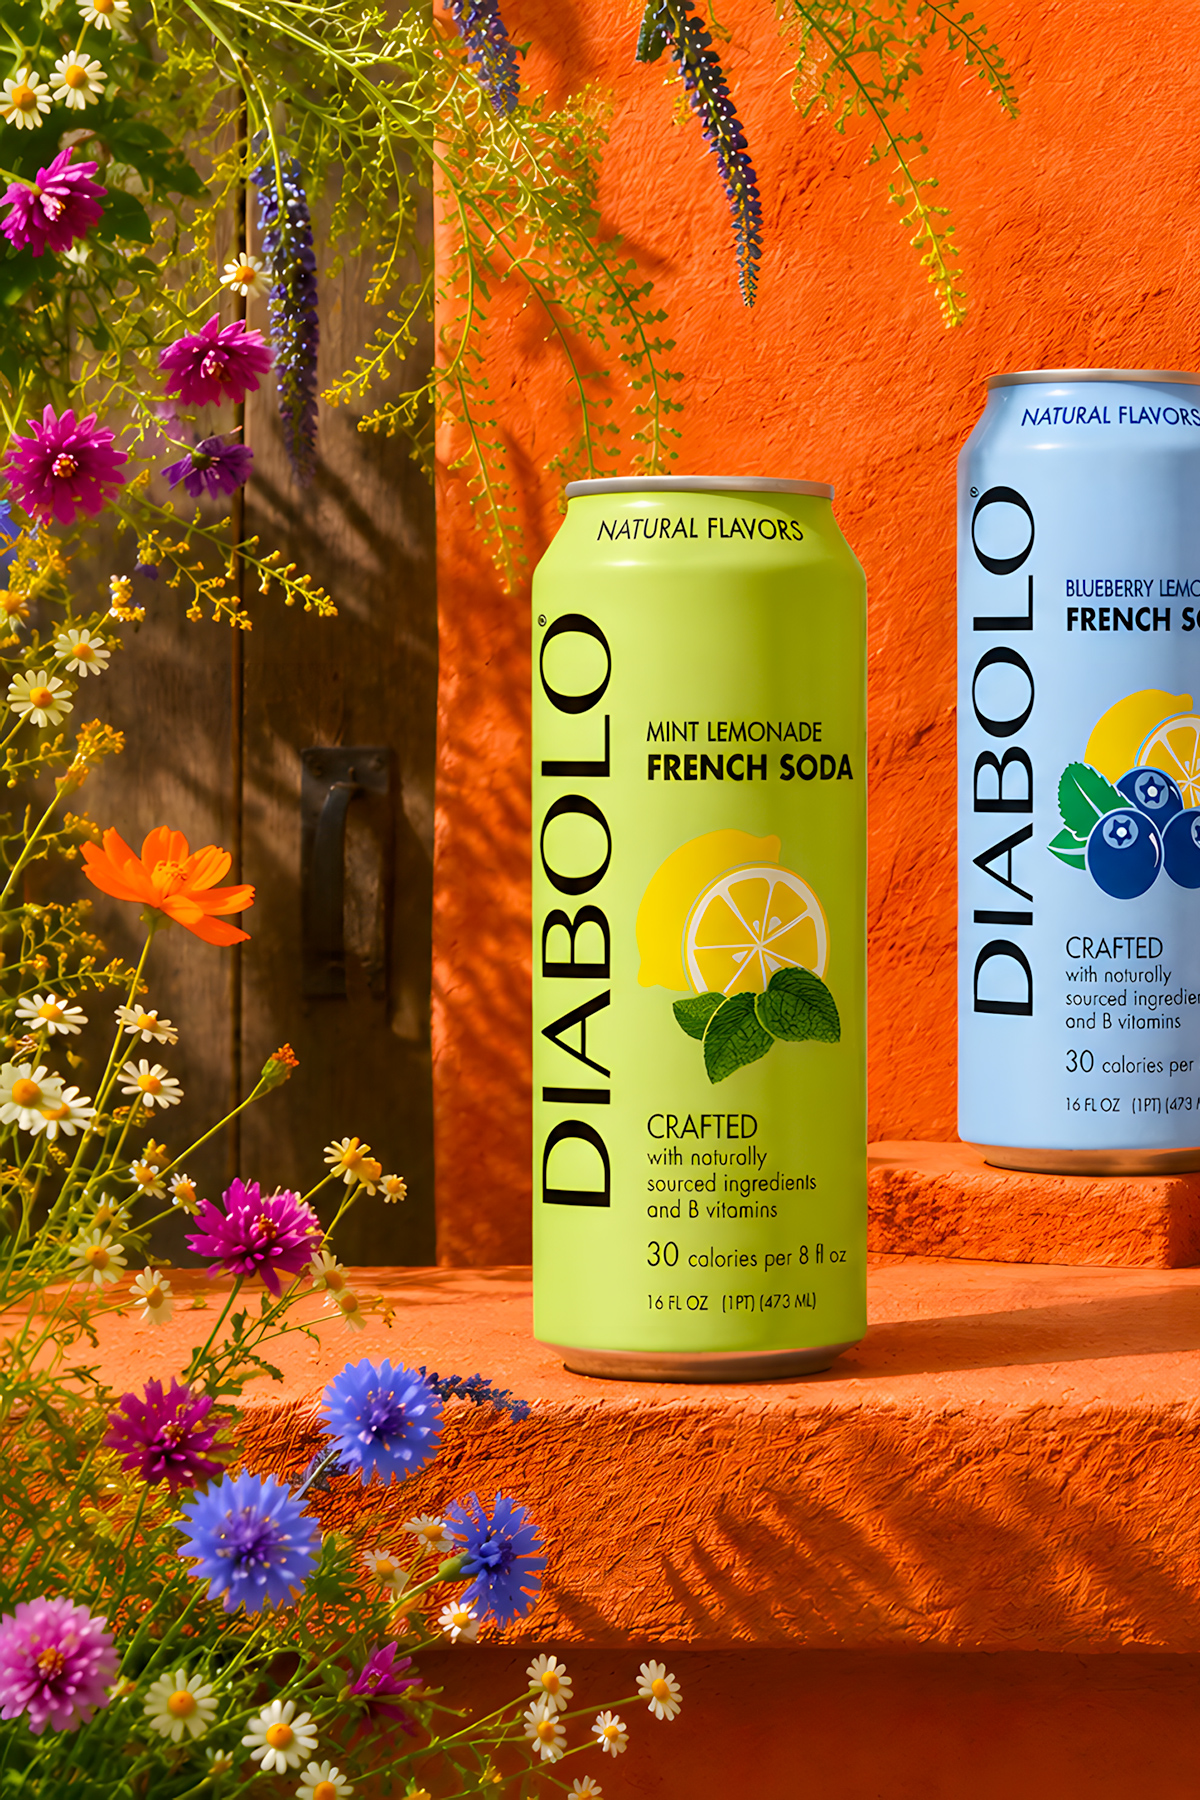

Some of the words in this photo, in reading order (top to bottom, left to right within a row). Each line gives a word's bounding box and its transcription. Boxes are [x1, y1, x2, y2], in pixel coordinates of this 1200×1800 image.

[1021, 406, 1111, 426] NATURAL
[597, 517, 698, 541] NATURAL
[707, 517, 804, 541] FLAVORS
[1066, 579, 1154, 597] BLUEBERRY
[1067, 607, 1171, 631] FRENCH
[646, 721, 699, 742] MINT
[707, 721, 822, 742] LEMONADE
[648, 754, 767, 780] FRENCH
[780, 754, 853, 780] SODA
[1066, 936, 1163, 959] CRAFTED
[1066, 965, 1097, 983] with
[1105, 964, 1172, 986] naturally
[1066, 989, 1127, 1006] sourced
[1066, 1013, 1096, 1029] and
[1103, 1013, 1112, 1029] B
[1118, 1013, 1181, 1029] vitamins
[1066, 1050, 1094, 1073] 30
[1102, 1055, 1163, 1073] calories
[1170, 1060, 1193, 1077] per
[1066, 1097, 1080, 1111] 16
[1085, 1098, 1097, 1111] FL
[1101, 1097, 1120, 1112] OZ
[1132, 1097, 1161, 1114] (1PT)
[647, 1114, 758, 1139] CRAFTED
[647, 1146, 683, 1166] with
[691, 1145, 767, 1170] naturally
[647, 1173, 716, 1192] sourced
[724, 1172, 817, 1197] ingredients
[647, 1200, 680, 1218] and
[689, 1201, 699, 1218] B
[706, 1201, 778, 1218] vitamins
[647, 1240, 679, 1267] 30
[688, 1246, 757, 1267] calories
[764, 1252, 792, 1271] per
[799, 1245, 809, 1265] 8
[815, 1243, 824, 1264] fl
[829, 1249, 847, 1263] oz
[648, 1295, 663, 1310] 16
[669, 1296, 682, 1310] FL
[686, 1295, 708, 1311] OZ
[722, 1294, 755, 1313] (1PT)
[760, 1294, 791, 1312] (473
[794, 1292, 817, 1310] ML)
